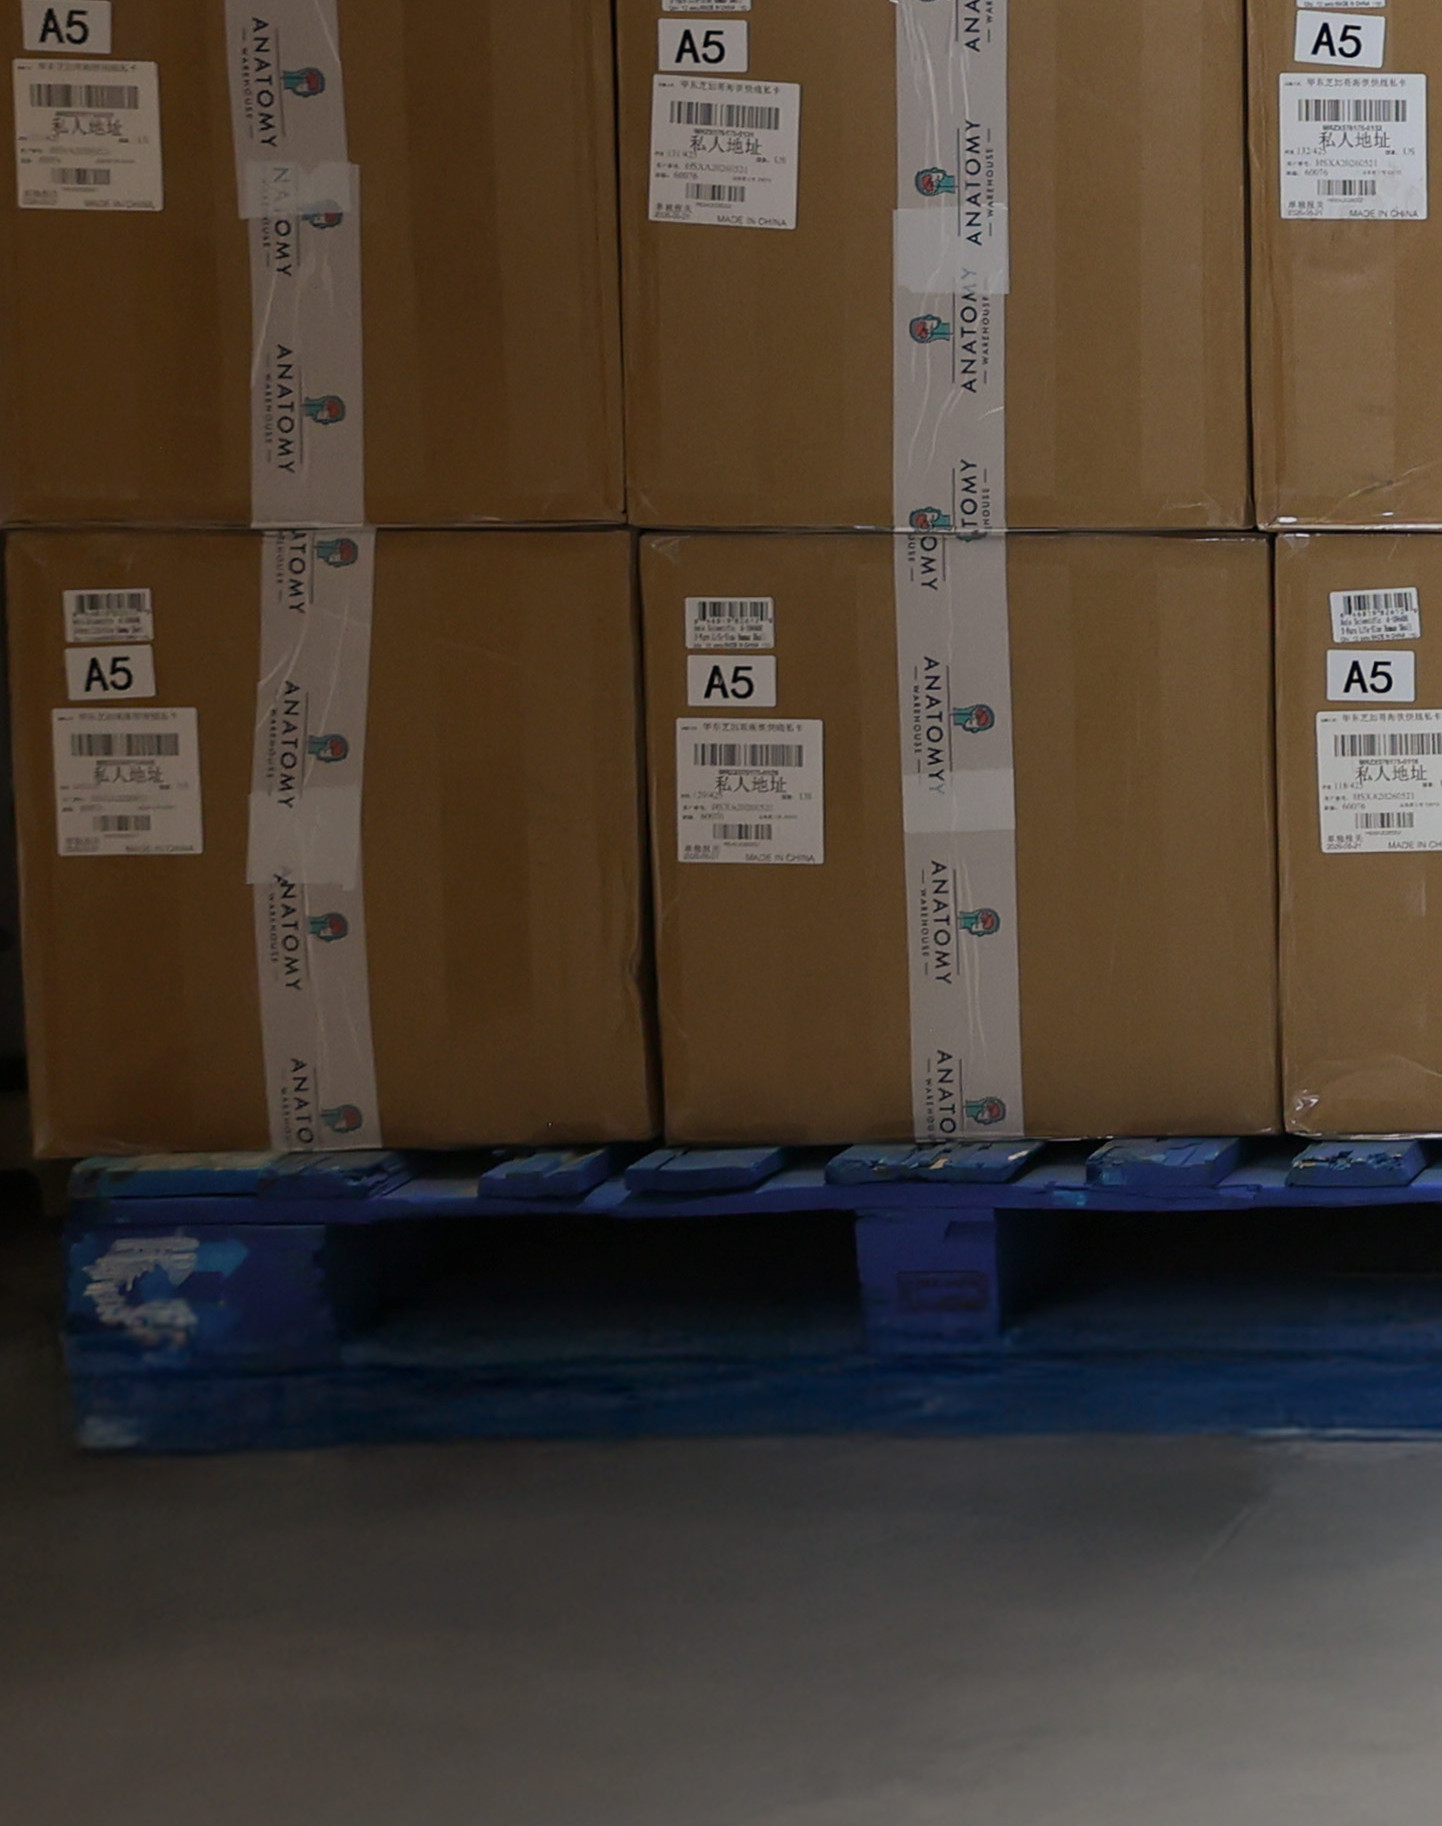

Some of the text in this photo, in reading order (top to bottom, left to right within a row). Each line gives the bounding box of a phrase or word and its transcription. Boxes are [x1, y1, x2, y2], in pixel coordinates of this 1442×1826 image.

[39, 7, 89, 45] A5
[1310, 22, 1362, 58] A5
[675, 29, 725, 64] A5
[242, 46, 253, 120] WAREHOUSE
[252, 16, 277, 149] ANATOMY
[689, 134, 762, 155] 私人地址
[1319, 131, 1391, 149] 私人地址
[965, 119, 982, 247] ANATOMY
[986, 148, 994, 217] WAREHOUSE
[1350, 209, 1419, 217] MADE IN CHINA
[961, 266, 977, 395] ANATOMY
[276, 344, 296, 474] ANATOMY
[85, 656, 132, 692] A5
[704, 665, 754, 699] A5
[1343, 660, 1393, 694] A5
[912, 684, 922, 754] WAREHOUSE
[923, 655, 945, 788] ANATOMY
[278, 680, 301, 810] ANATOMY
[714, 775, 787, 793] 私人地址
[1355, 764, 1428, 783] 私人地址
[1388, 842, 1414, 850] MADE
[1417, 841, 1426, 849] IN
[919, 887, 930, 957] WAREHOUSE
[931, 859, 952, 985] ANATOMY
